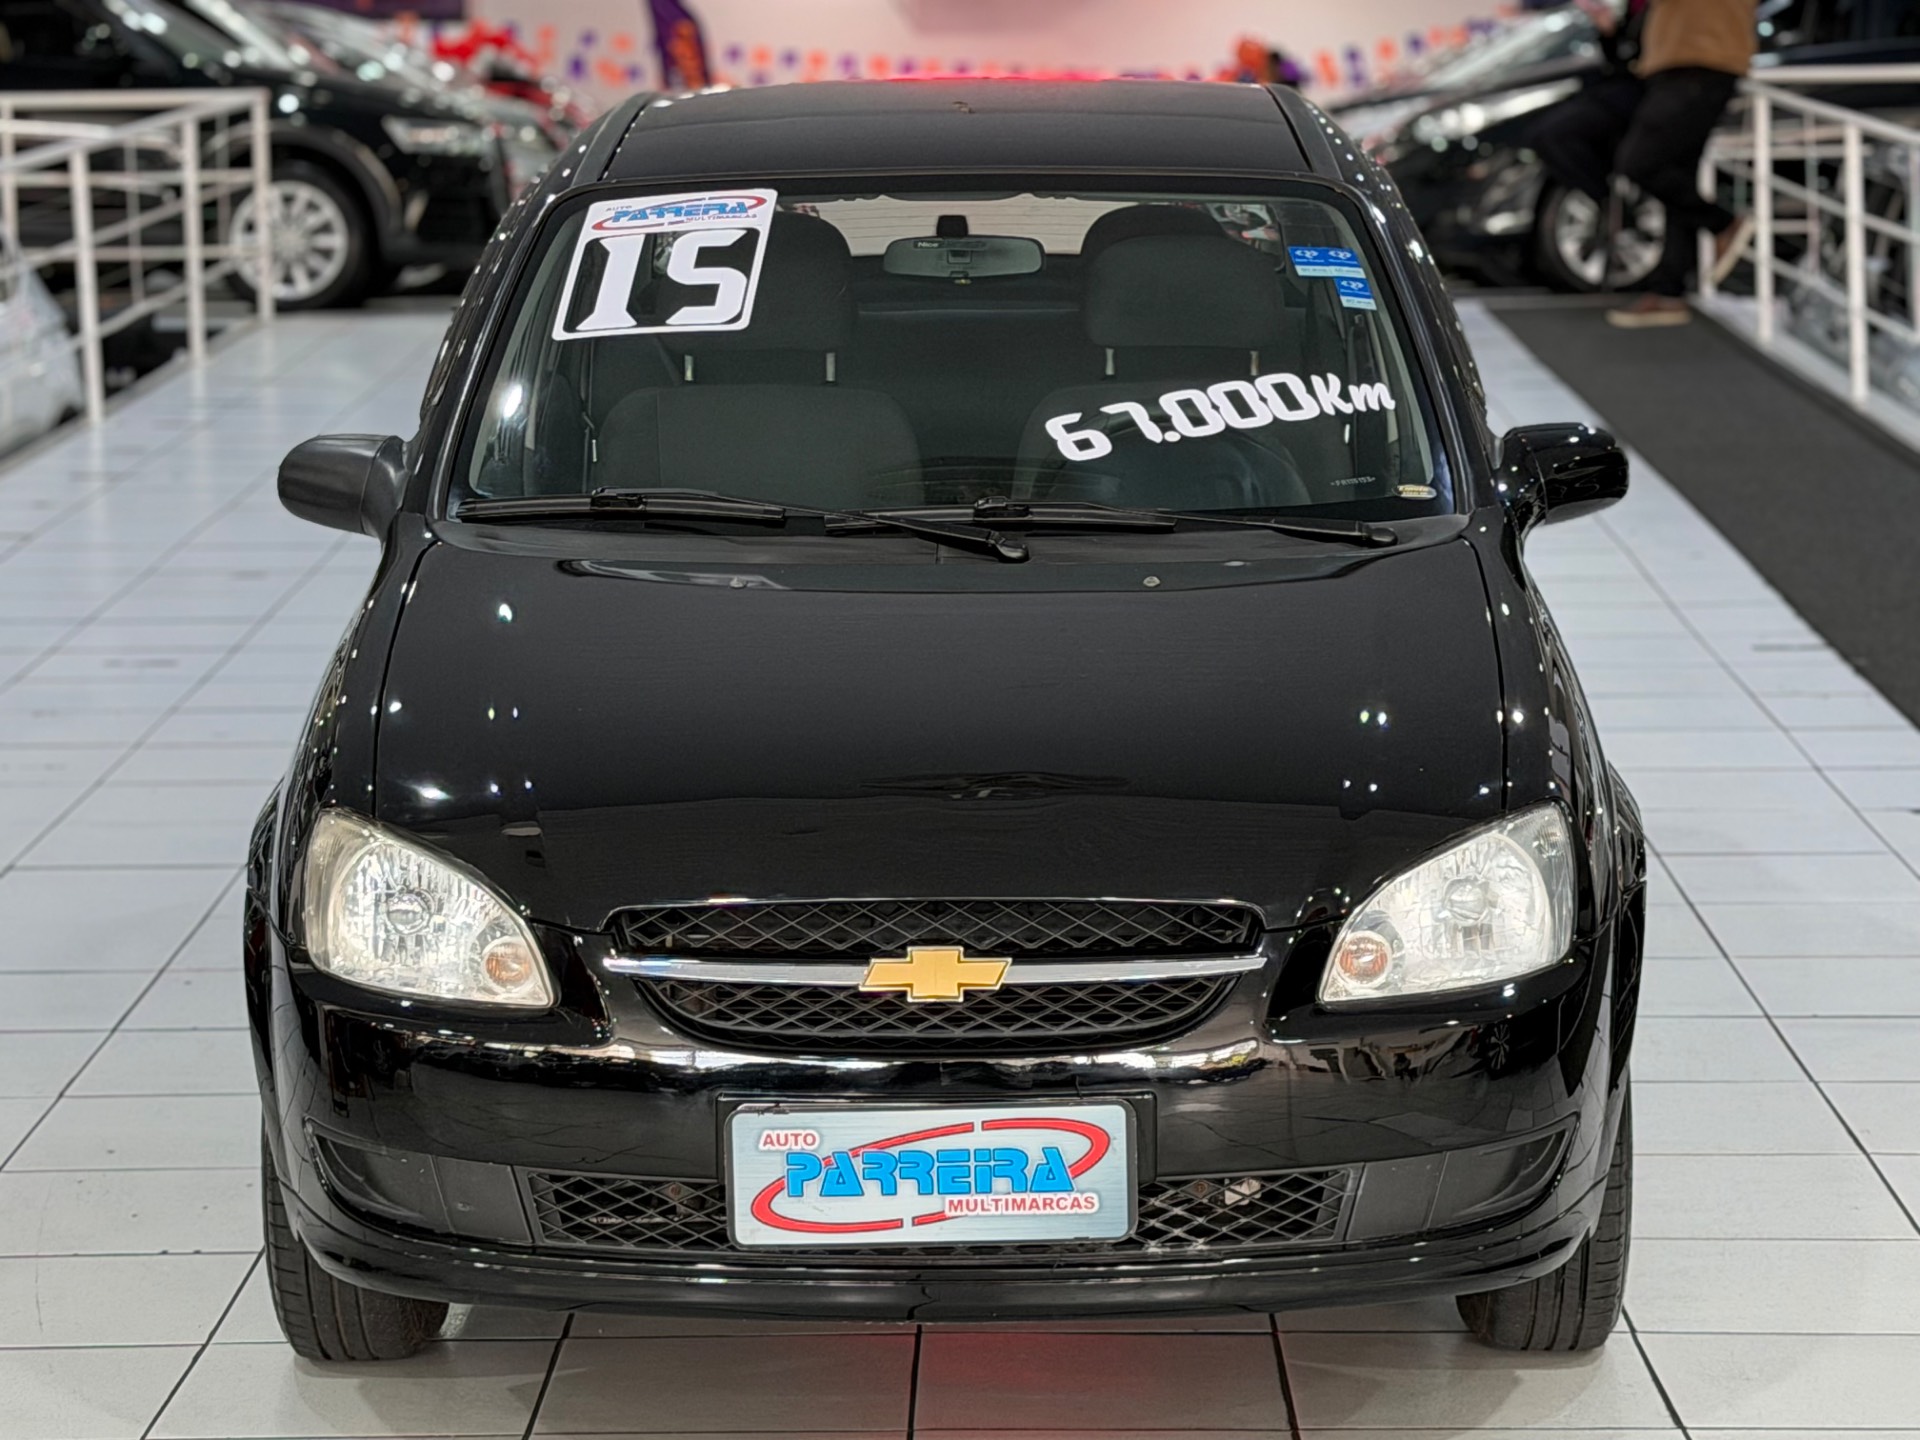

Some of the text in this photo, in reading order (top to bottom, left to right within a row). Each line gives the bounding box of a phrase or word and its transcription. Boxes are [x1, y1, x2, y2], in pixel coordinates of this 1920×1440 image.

[575, 229, 748, 331] 15
[762, 1130, 818, 1148] AUTO
[785, 1146, 1076, 1198] PARREIRA
[947, 1196, 1097, 1213] MULTIMARCAS
